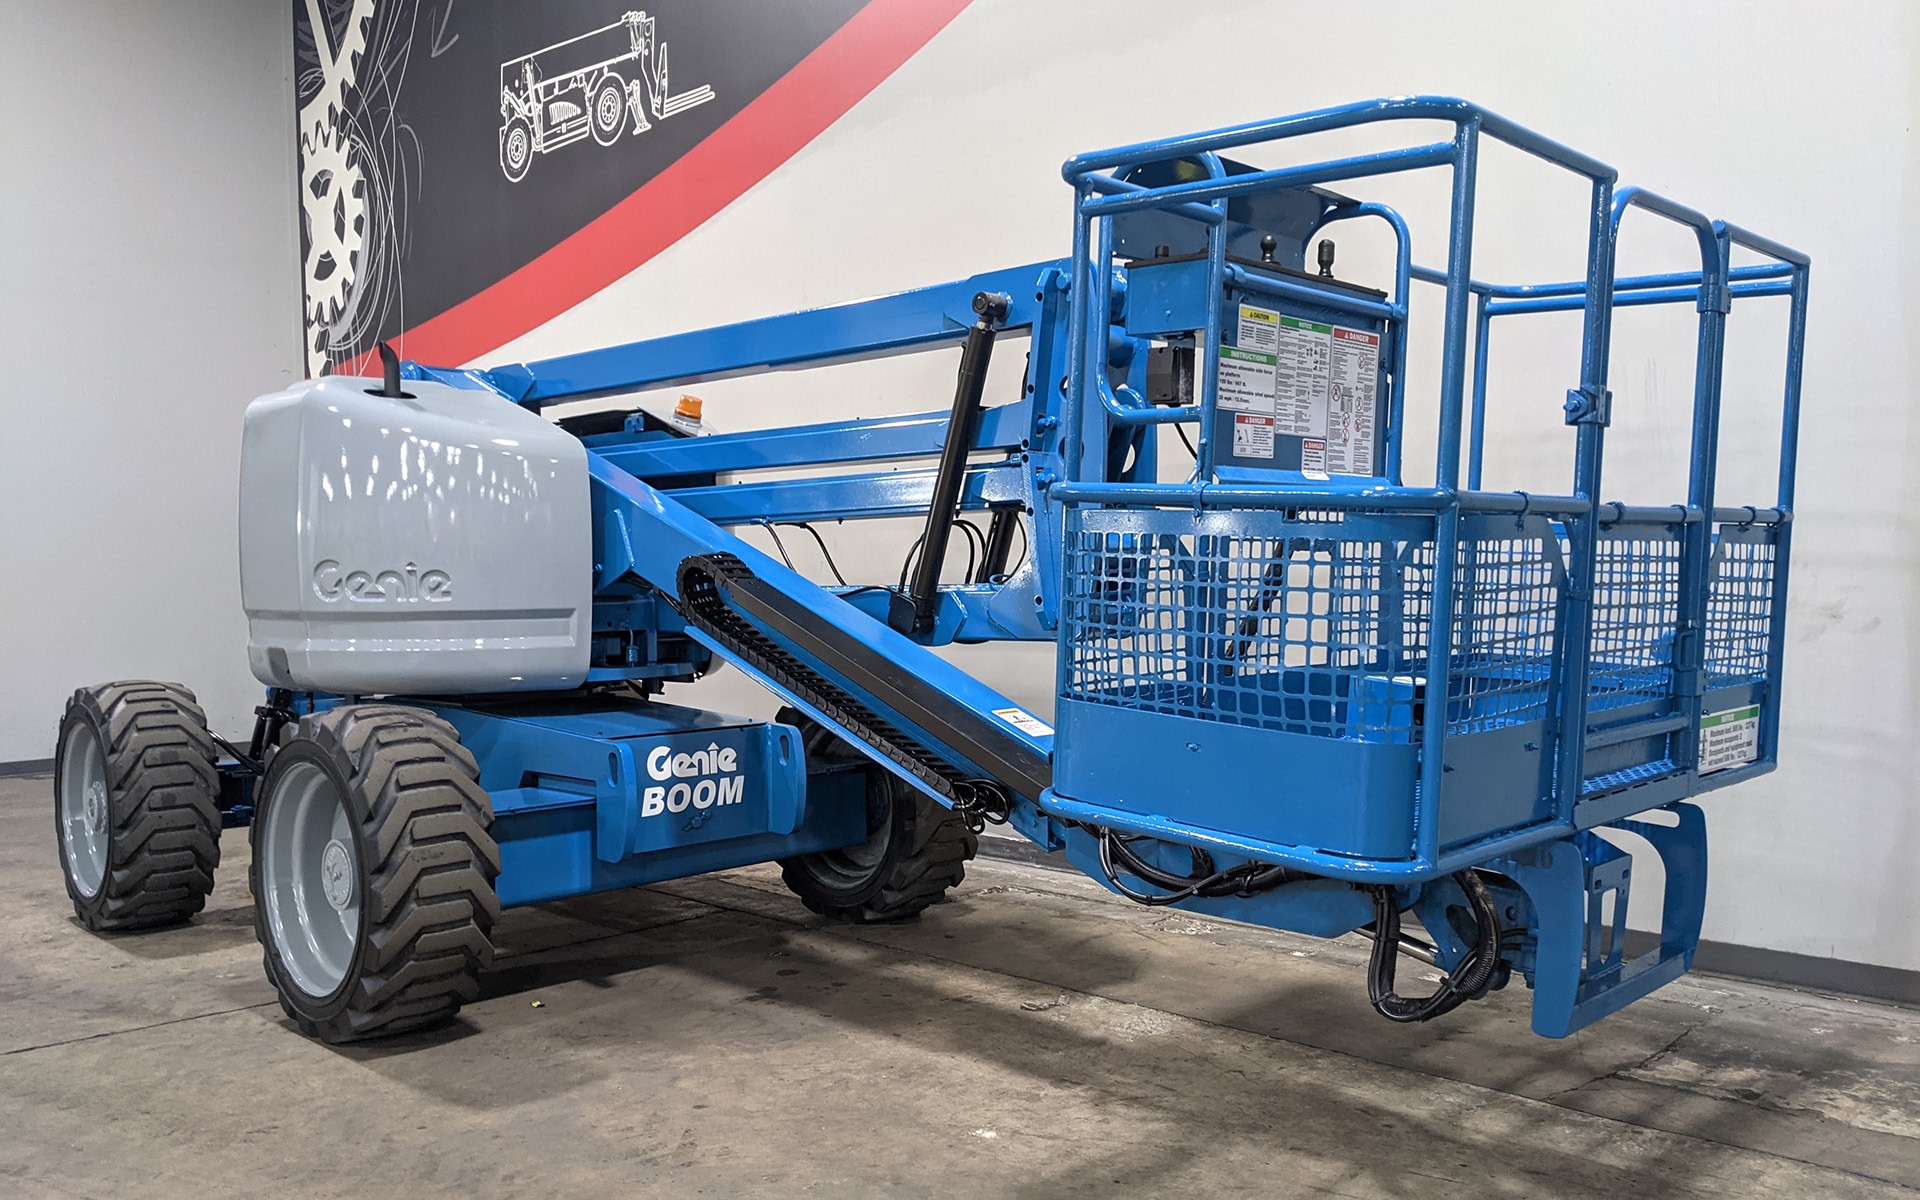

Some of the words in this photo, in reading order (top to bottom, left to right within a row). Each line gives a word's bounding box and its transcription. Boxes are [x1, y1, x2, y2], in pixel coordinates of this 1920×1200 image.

[1254, 312, 1270, 320] CAUTION
[1298, 322, 1312, 330] NOTICE
[1350, 332, 1370, 342] DANGER
[1230, 350, 1267, 362] INSTRUCTIONS
[313, 558, 452, 602] Genie
[647, 742, 737, 781] Genie
[641, 775, 744, 818] BOOM
